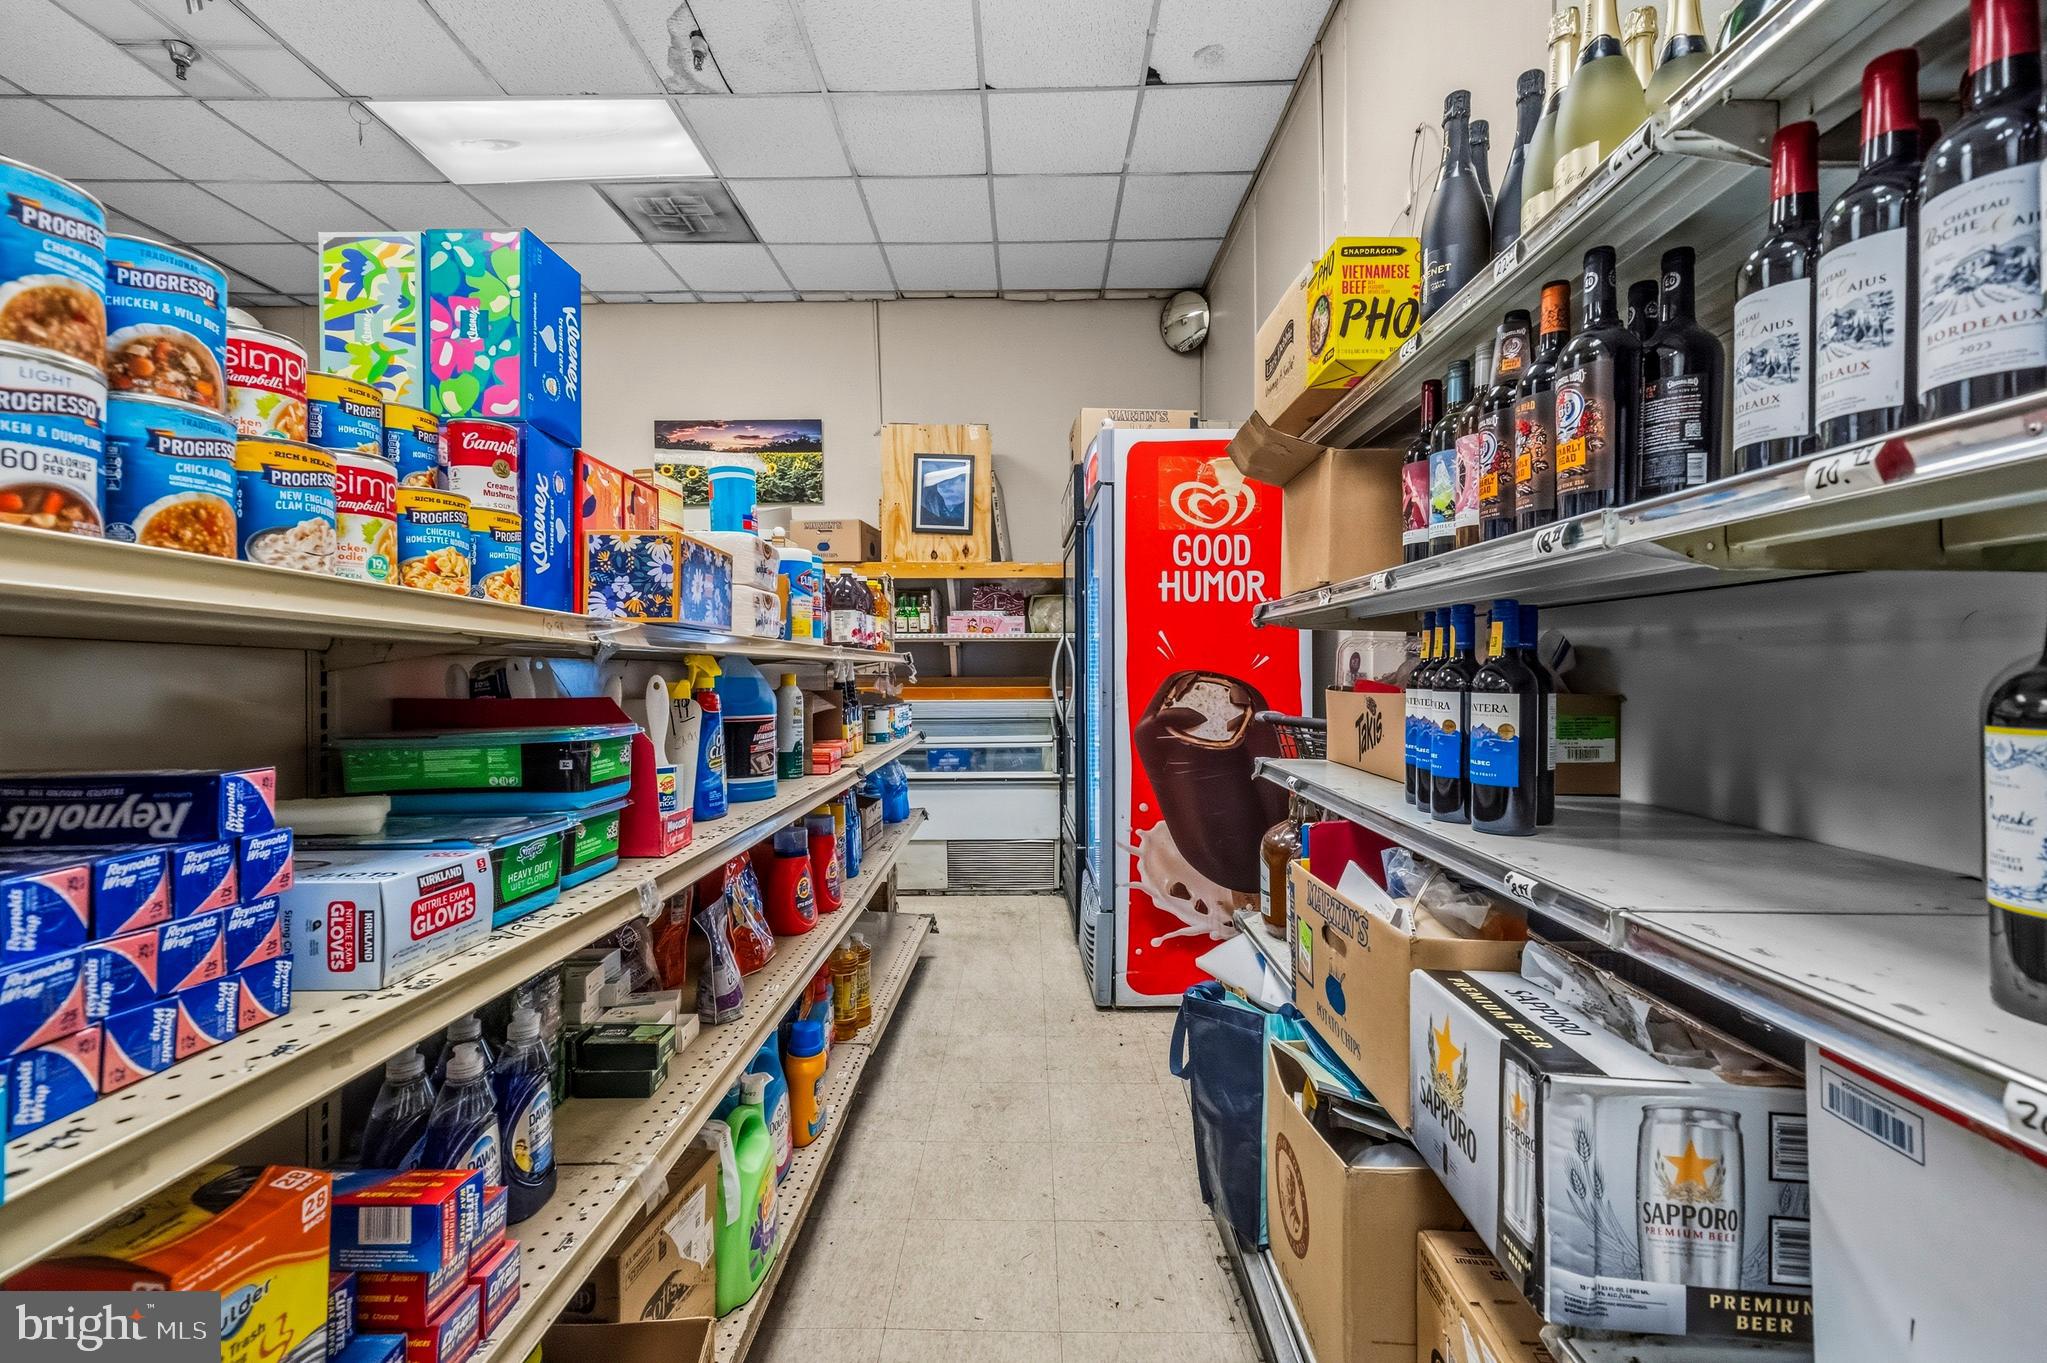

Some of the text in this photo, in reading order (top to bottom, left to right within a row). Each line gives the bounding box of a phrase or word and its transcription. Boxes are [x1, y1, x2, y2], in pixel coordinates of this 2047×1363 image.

[1343, 247, 1399, 255] SNAPDRAGON
[117, 267, 216, 301] PROGRESSO
[1342, 264, 1410, 279] VIETNAMESE
[1342, 280, 1367, 295] BEEF
[104, 295, 158, 312] CHICKEN
[161, 302, 171, 314] &
[174, 305, 202, 327] WILD
[1339, 296, 1419, 341] PHO
[1928, 309, 2044, 346] BORDEAUX
[563, 307, 580, 402] Kleenex
[19, 366, 72, 388] LIGHT
[1108, 409, 1169, 423] MARTIN'S
[36, 428, 47, 438] &
[42, 453, 92, 472] CALORIES
[274, 451, 300, 460] RICH
[43, 465, 87, 481] PER CAN
[275, 500, 302, 510] CLAM
[280, 490, 302, 500] NEW
[413, 511, 468, 524] PROGRESSO
[530, 473, 550, 574] Kleenex
[406, 535, 449, 544] HOMESTYLE
[426, 528, 455, 537] CHICKEN
[1172, 533, 1251, 567] GOOD
[1158, 570, 1268, 602] HUMOR
[1355, 711, 1385, 763] Takis
[1, 793, 193, 840] Reynolds
[224, 782, 236, 832] Reynolds
[234, 803, 245, 834] Wrap
[185, 843, 230, 864] Reynolds
[246, 846, 271, 861] Wrap
[250, 833, 289, 850] Reynolds
[106, 855, 161, 878] Reynolds
[181, 860, 209, 876] Wrap
[420, 866, 462, 888] KIRKLAND
[508, 859, 553, 884] HEAVY DUTY
[102, 874, 137, 891] Wrap
[510, 871, 551, 891] WET CLOTHS
[231, 899, 276, 920] Reynolds
[418, 887, 470, 912] NITRILE EXAM
[227, 915, 256, 932] Wrap
[283, 910, 293, 939] Sizing
[413, 897, 474, 936] GLOVES
[1307, 879, 1369, 948] MARTIN'S
[166, 916, 217, 939] Reynolds
[330, 904, 345, 970] GLOVES
[345, 908, 353, 965] NITRILE EXAM
[364, 912, 374, 961] KIRKLAND
[162, 935, 194, 952] Wrap
[274, 960, 282, 990] Wrap
[282, 960, 292, 1008] Reynolds
[218, 982, 229, 1014] Wrap
[228, 982, 239, 1033] Reynolds
[152, 1008, 162, 1042] Wrap
[1447, 976, 1554, 1051] PREMIUM BEER
[1504, 988, 1592, 1037] SAPPORO
[161, 1008, 177, 1064] Reynolds
[1316, 1001, 1362, 1060] POTATO CHIPS
[1419, 1074, 1478, 1165] SAPPORO
[467, 1143, 498, 1170] DAWN
[305, 1190, 327, 1217] 28
[1643, 1201, 1738, 1232] SAPPORO
[1645, 1226, 1703, 1239] PREMIUM
[1502, 1234, 1532, 1270] PREMIUM
[1507, 1252, 1522, 1274] BEER
[1735, 1315, 1794, 1335] BEER
